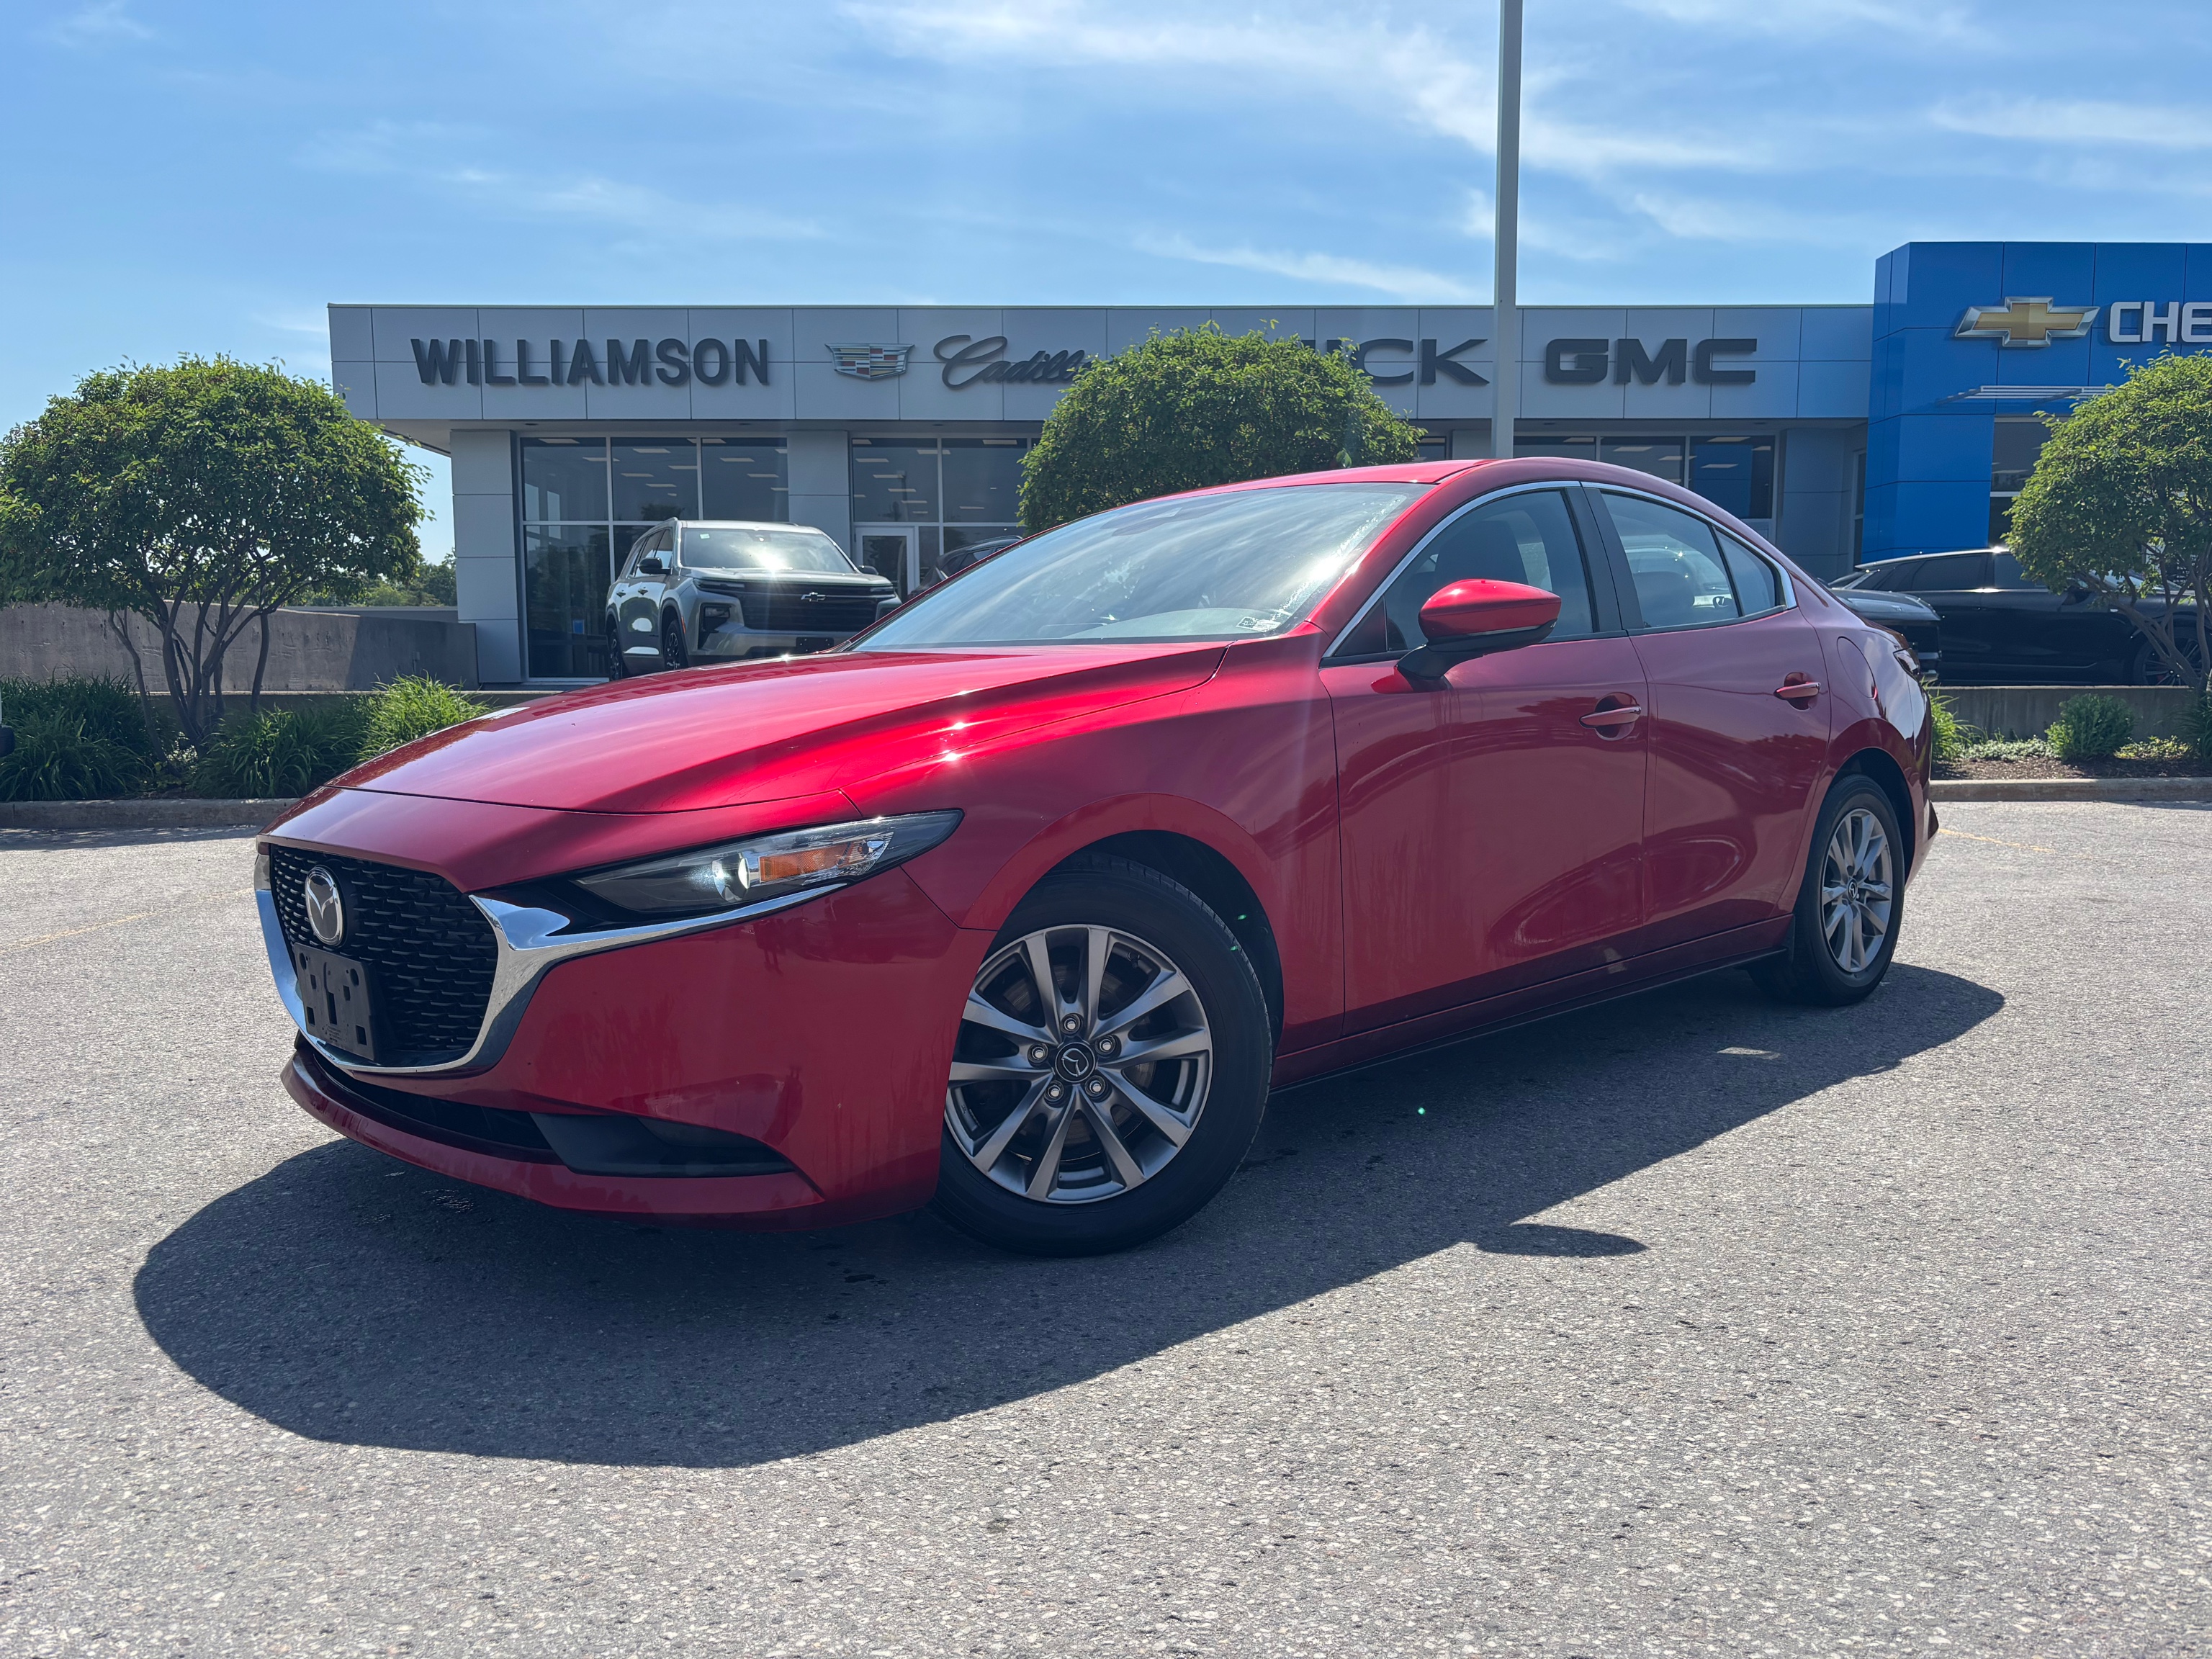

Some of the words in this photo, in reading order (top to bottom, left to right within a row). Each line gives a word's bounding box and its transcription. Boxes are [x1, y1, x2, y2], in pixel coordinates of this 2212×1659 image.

[410, 338, 770, 386] WILLIAMSON
[933, 334, 1094, 391] Cadill
[1545, 338, 1758, 385] GMC
